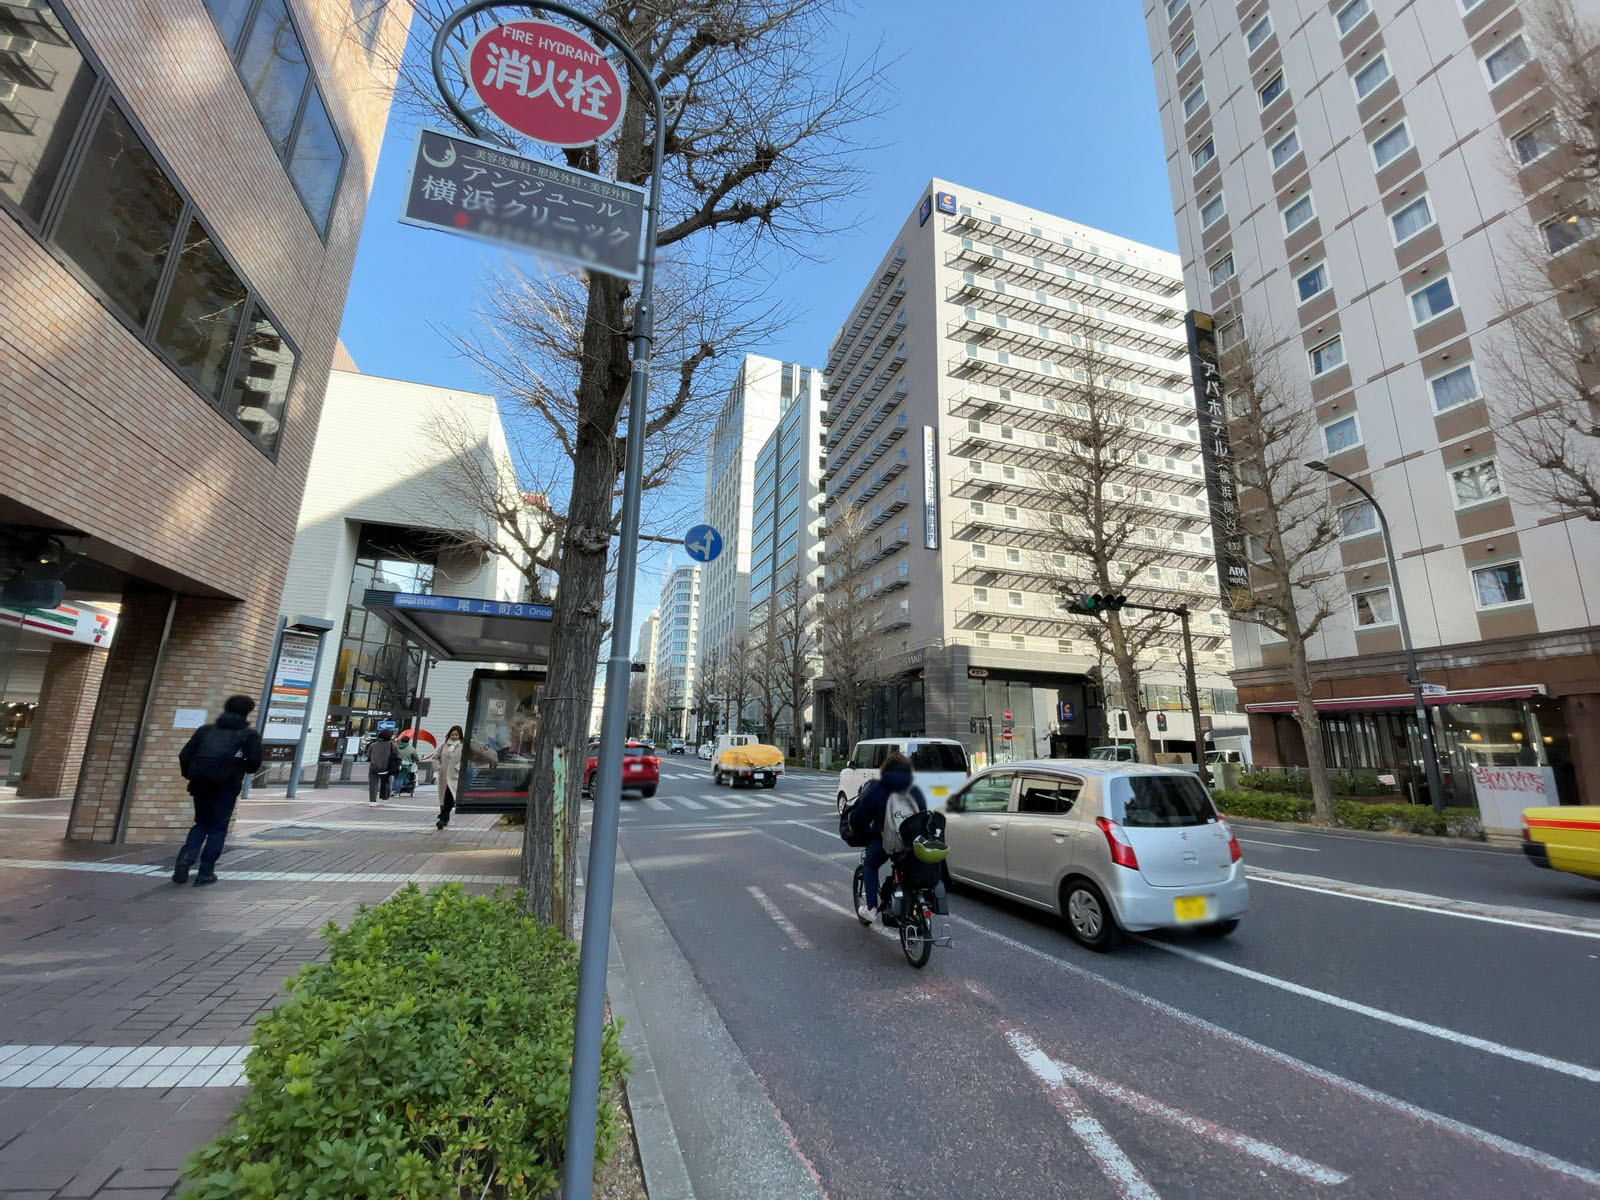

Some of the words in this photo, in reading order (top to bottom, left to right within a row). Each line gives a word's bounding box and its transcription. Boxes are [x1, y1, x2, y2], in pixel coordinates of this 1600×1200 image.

[502, 26, 533, 46] FIRE
[539, 36, 602, 66] HYDRANT
[482, 42, 612, 121] 消火栓
[421, 174, 631, 245] 横浜クリニック
[462, 162, 622, 218] アンジュール
[1229, 566, 1247, 577] APA
